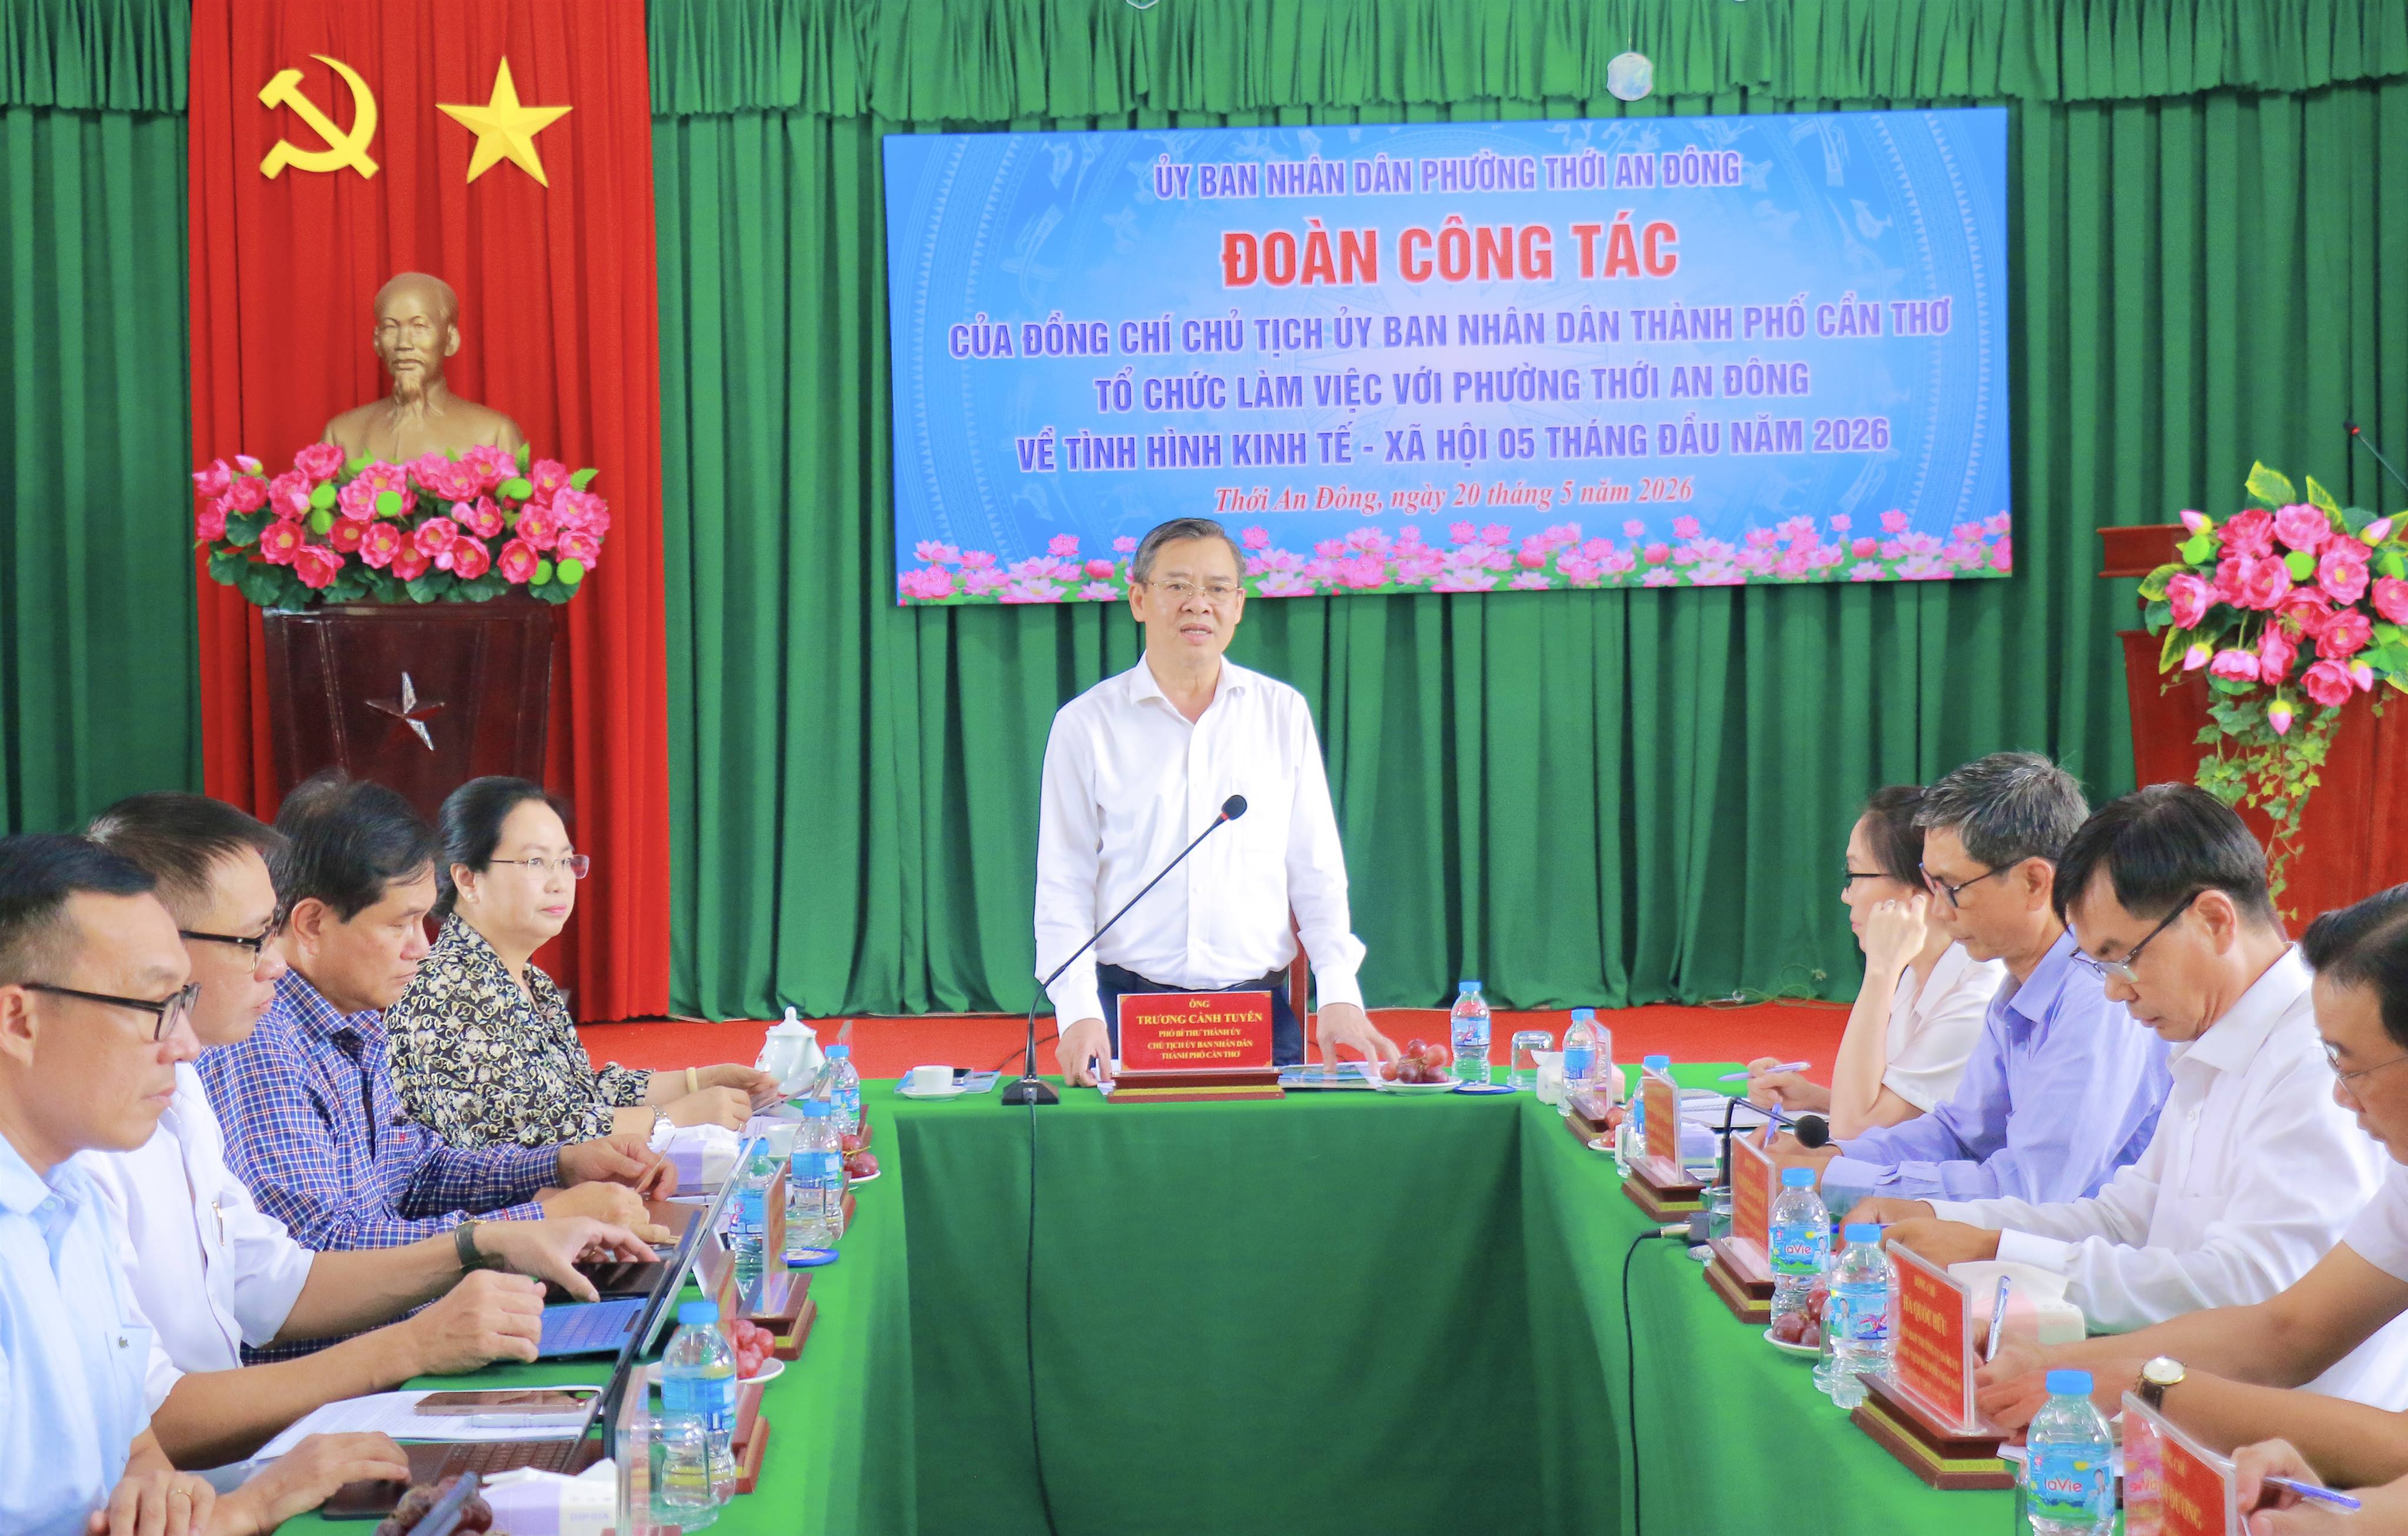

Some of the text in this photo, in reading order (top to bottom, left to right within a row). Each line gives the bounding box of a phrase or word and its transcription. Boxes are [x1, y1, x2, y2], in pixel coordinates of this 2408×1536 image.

[1154, 146, 1739, 198] ỦY BAN NHÂN DÂN PHƯỜNG THỚI AN ĐÔNG
[1222, 208, 1677, 286] ĐOÀN CÔNG TÁC
[950, 292, 1950, 358] CỦA ĐỒNG CHÍ CHỦ TỊCH ỦY BAN NHÂN DÂN THÀNH PHỐ CẦN THƠ
[1094, 358, 1808, 413] TỔ CHỨC LÀM VIỆC VỚI PHƯỜNG THỚI AN ĐÔNG
[1018, 427, 1055, 471] VỀ
[1064, 430, 1136, 469] TÌNH
[1147, 429, 1221, 468] HÌNH
[1232, 432, 1306, 466] KINH
[1316, 420, 1353, 463] TẾ
[1384, 423, 1426, 462] XÃ
[1436, 422, 1487, 468] HỘI
[1498, 428, 1535, 459] 05
[1544, 418, 1647, 458] THÁNG
[1657, 412, 1720, 456] ĐẦU
[1731, 414, 1802, 453] NĂM
[1814, 418, 1888, 451] 2026
[1215, 477, 1693, 515] Thới An Đông, ngày 20 tháng 5 năm 2026
[1136, 1010, 1263, 1025] TRƯƠNG CẢNH TUYÊN
[1189, 999, 1210, 1009] ÔNG
[1213, 1039, 1235, 1048] NHÂN
[1236, 1039, 1253, 1047] DÂN
